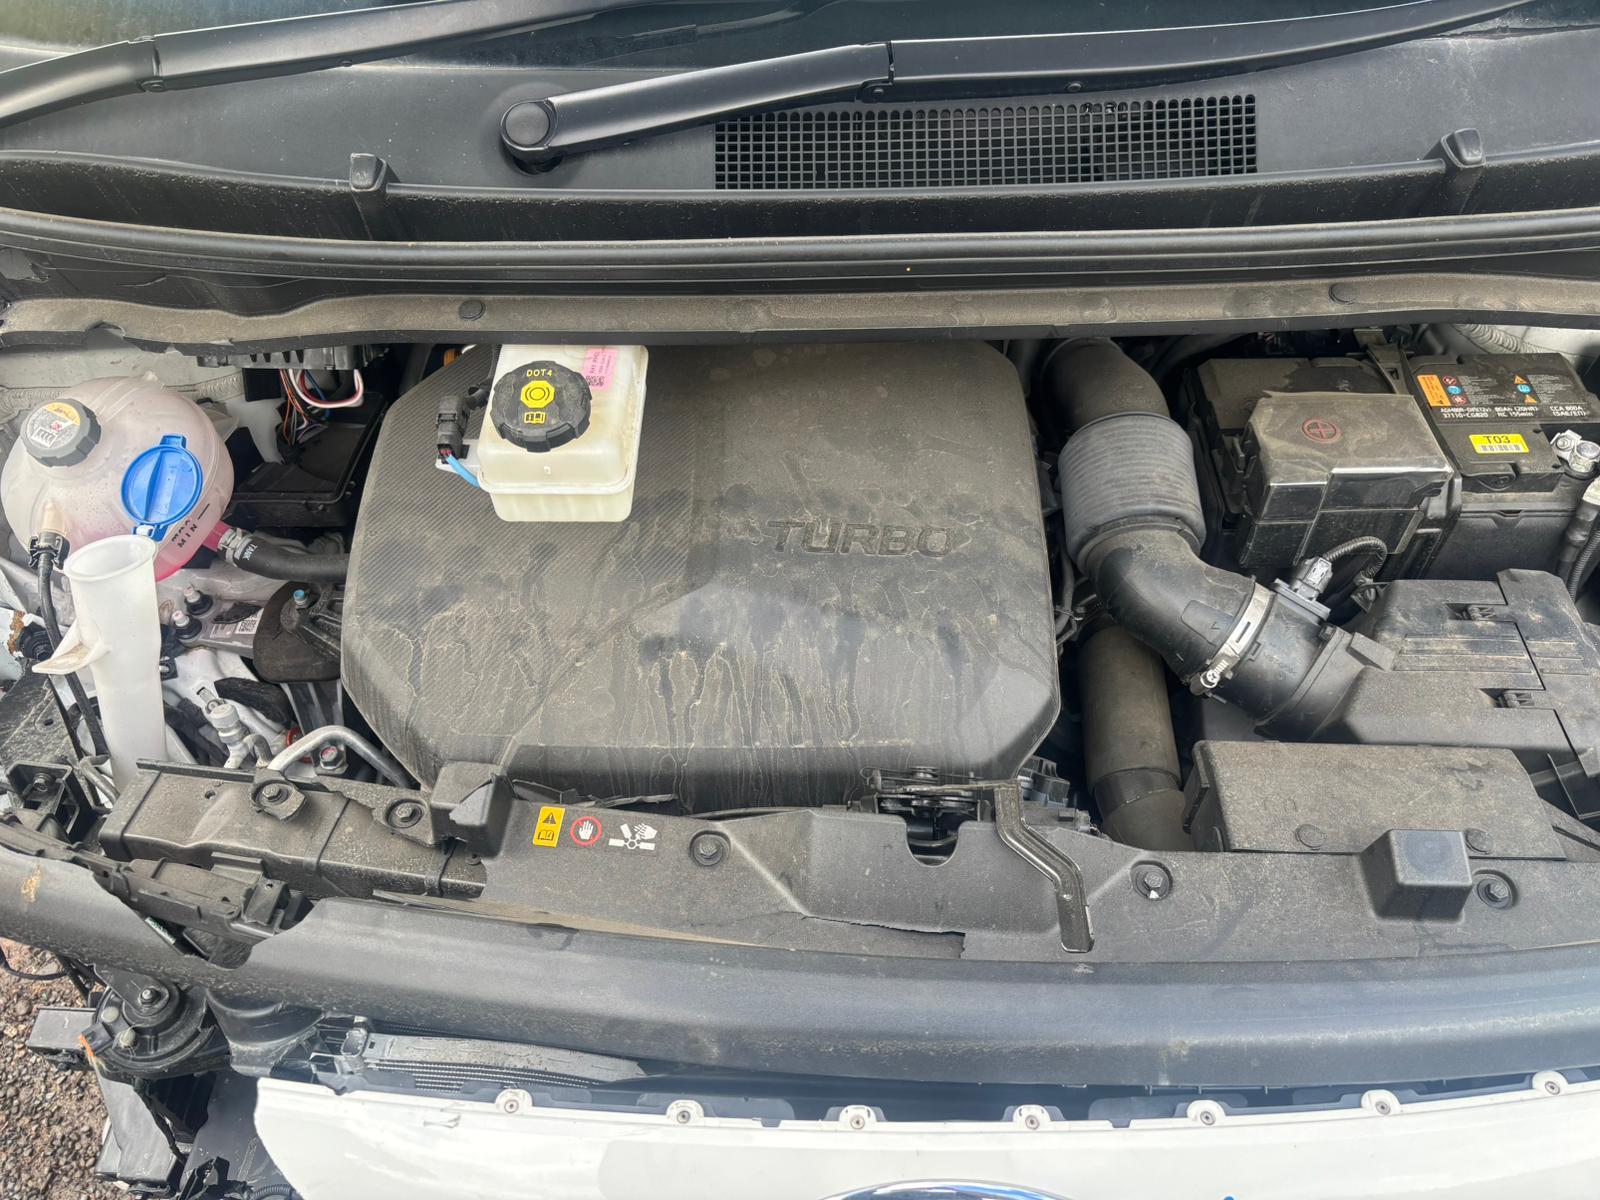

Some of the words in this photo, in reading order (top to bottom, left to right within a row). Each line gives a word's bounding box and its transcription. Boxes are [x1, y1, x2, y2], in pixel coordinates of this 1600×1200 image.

[1483, 435, 1511, 444] T03
[176, 523, 198, 548] MIN
[766, 519, 951, 558] TURBO
